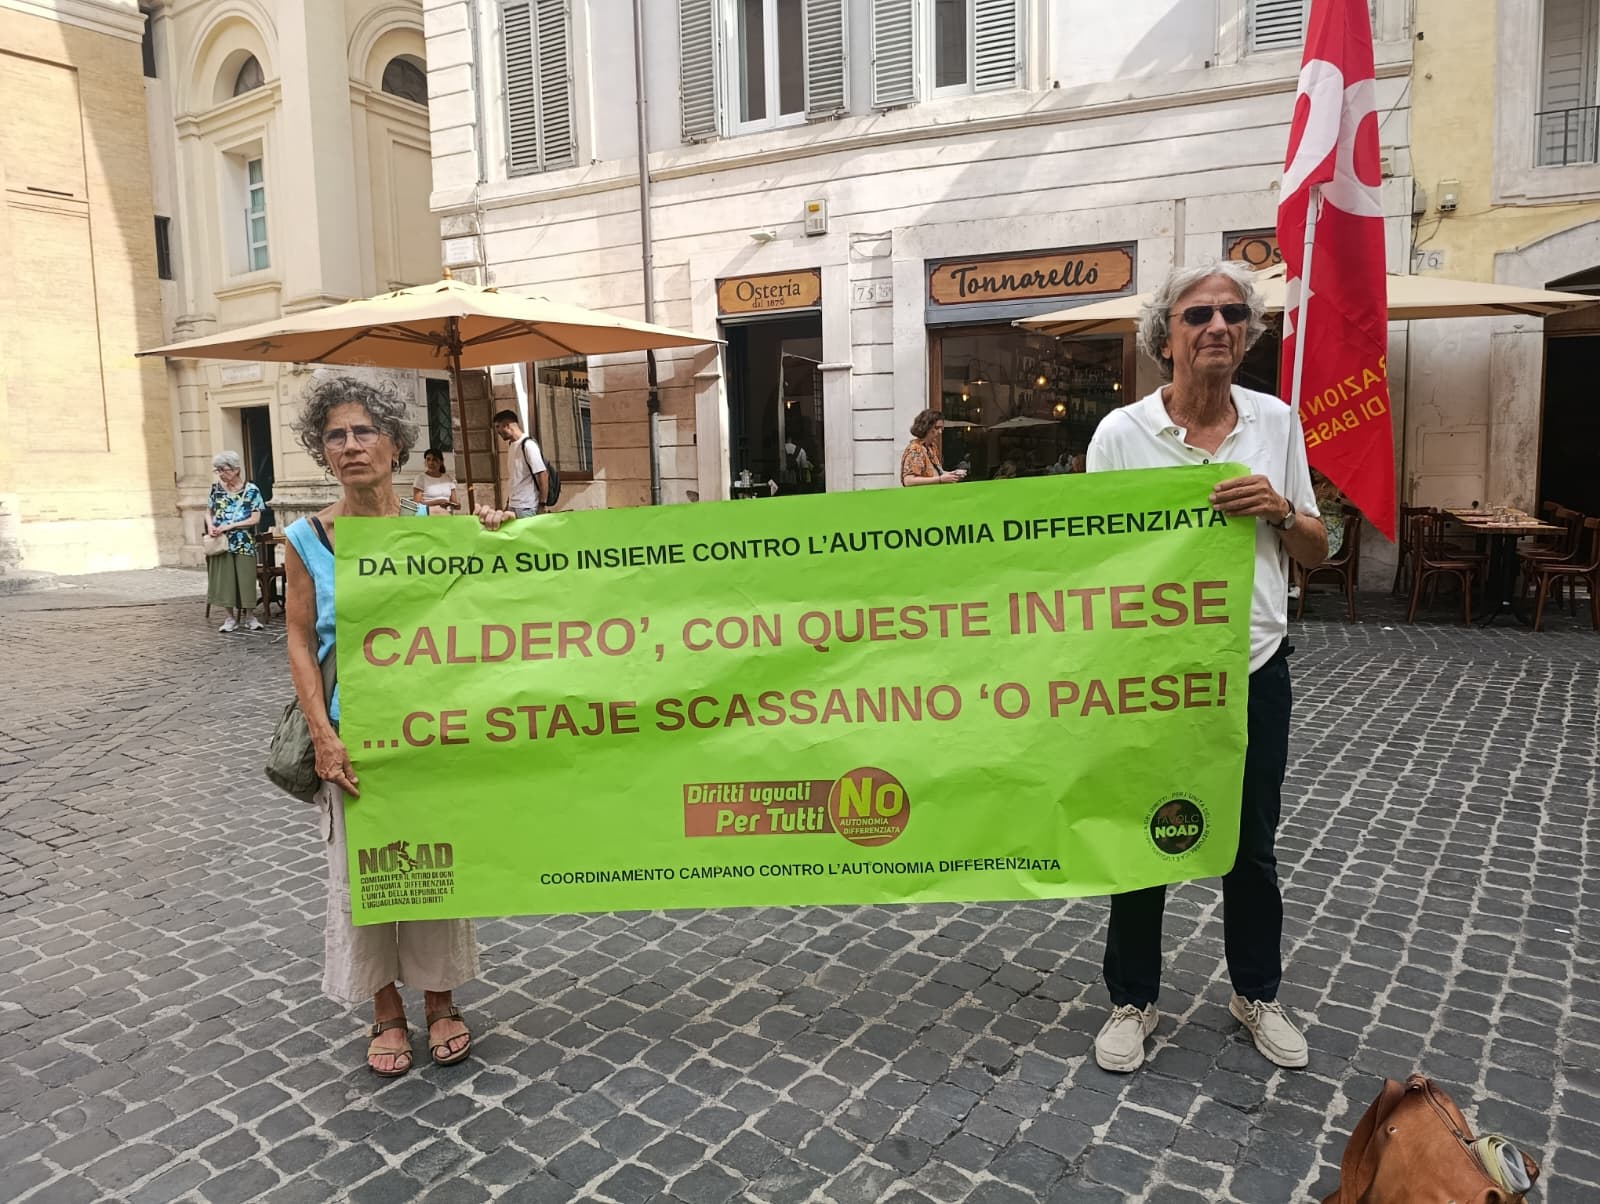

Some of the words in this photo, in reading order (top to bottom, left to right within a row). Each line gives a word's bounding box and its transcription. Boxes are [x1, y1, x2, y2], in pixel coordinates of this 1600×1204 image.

[1415, 252, 1441, 268] 76
[358, 556, 398, 576] DA
[406, 554, 484, 576] NORD
[491, 554, 509, 573] A
[515, 552, 570, 573] SUD
[577, 544, 686, 570] INSIEME
[693, 536, 801, 562] CONTRO
[808, 523, 995, 555] L'AUTONOMIA
[1002, 507, 1228, 542] DIFFERENZIATA
[362, 616, 666, 667] CALDERO',
[682, 613, 782, 652] CON
[797, 602, 991, 652] QUESTE
[1008, 581, 1230, 635] INTESE
[362, 709, 470, 750] ...CE
[485, 700, 640, 743] STAJE
[655, 685, 962, 731] SCASSANNO
[979, 682, 1031, 721] 'O
[1048, 672, 1228, 718] PAESE!
[687, 783, 745, 804] Diritti
[749, 782, 811, 806] uguali
[716, 809, 760, 833] Per
[766, 806, 824, 832] Tutti
[840, 818, 889, 827] AUTONOMIA
[843, 826, 901, 835] DIFFERENZIATA
[1155, 824, 1199, 839] NOAD
[540, 868, 675, 885] COORDINAMENTO
[679, 865, 755, 880] CAMPANO
[759, 863, 824, 877] CONTRO
[829, 861, 935, 875] L'AUTONOMIA
[939, 857, 1061, 872] DIFFERENZIATA
[361, 882, 401, 892] AUTONOMIA
[404, 879, 454, 888] DIFFERENZIATA
[388, 890, 408, 898] DELLA
